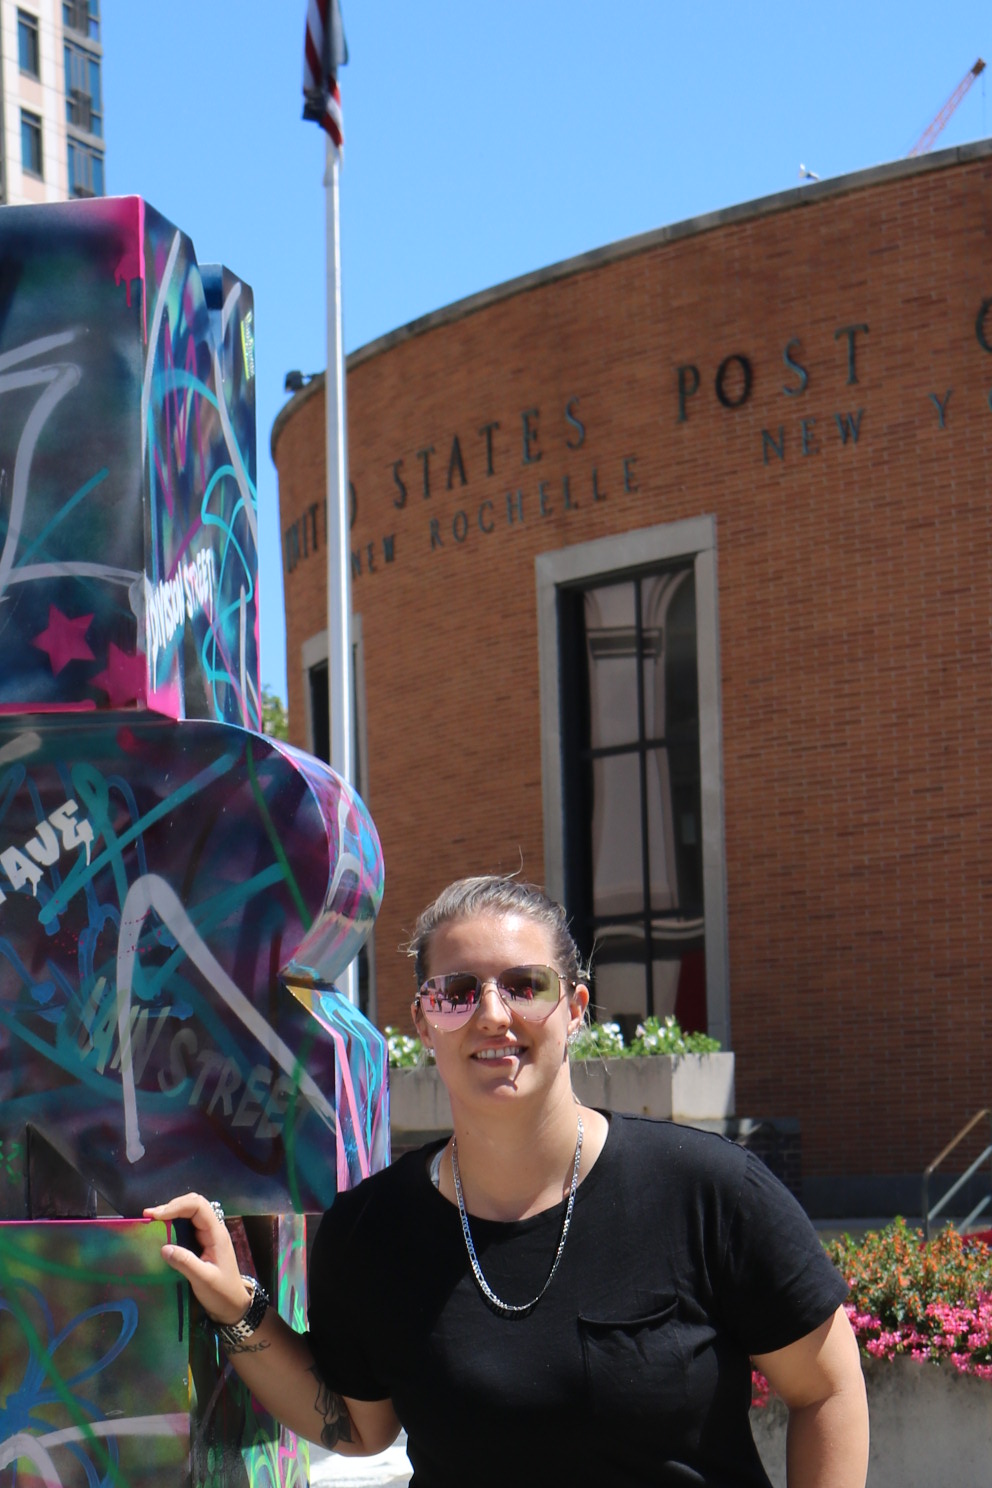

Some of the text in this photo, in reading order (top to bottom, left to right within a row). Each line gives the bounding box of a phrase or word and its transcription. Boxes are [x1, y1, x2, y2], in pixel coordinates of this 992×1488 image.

[351, 532, 396, 581] NEW
[429, 455, 640, 551] ROCHELLE
[761, 408, 864, 466] NEW
[392, 396, 585, 511] STATES
[676, 323, 870, 424] POST
